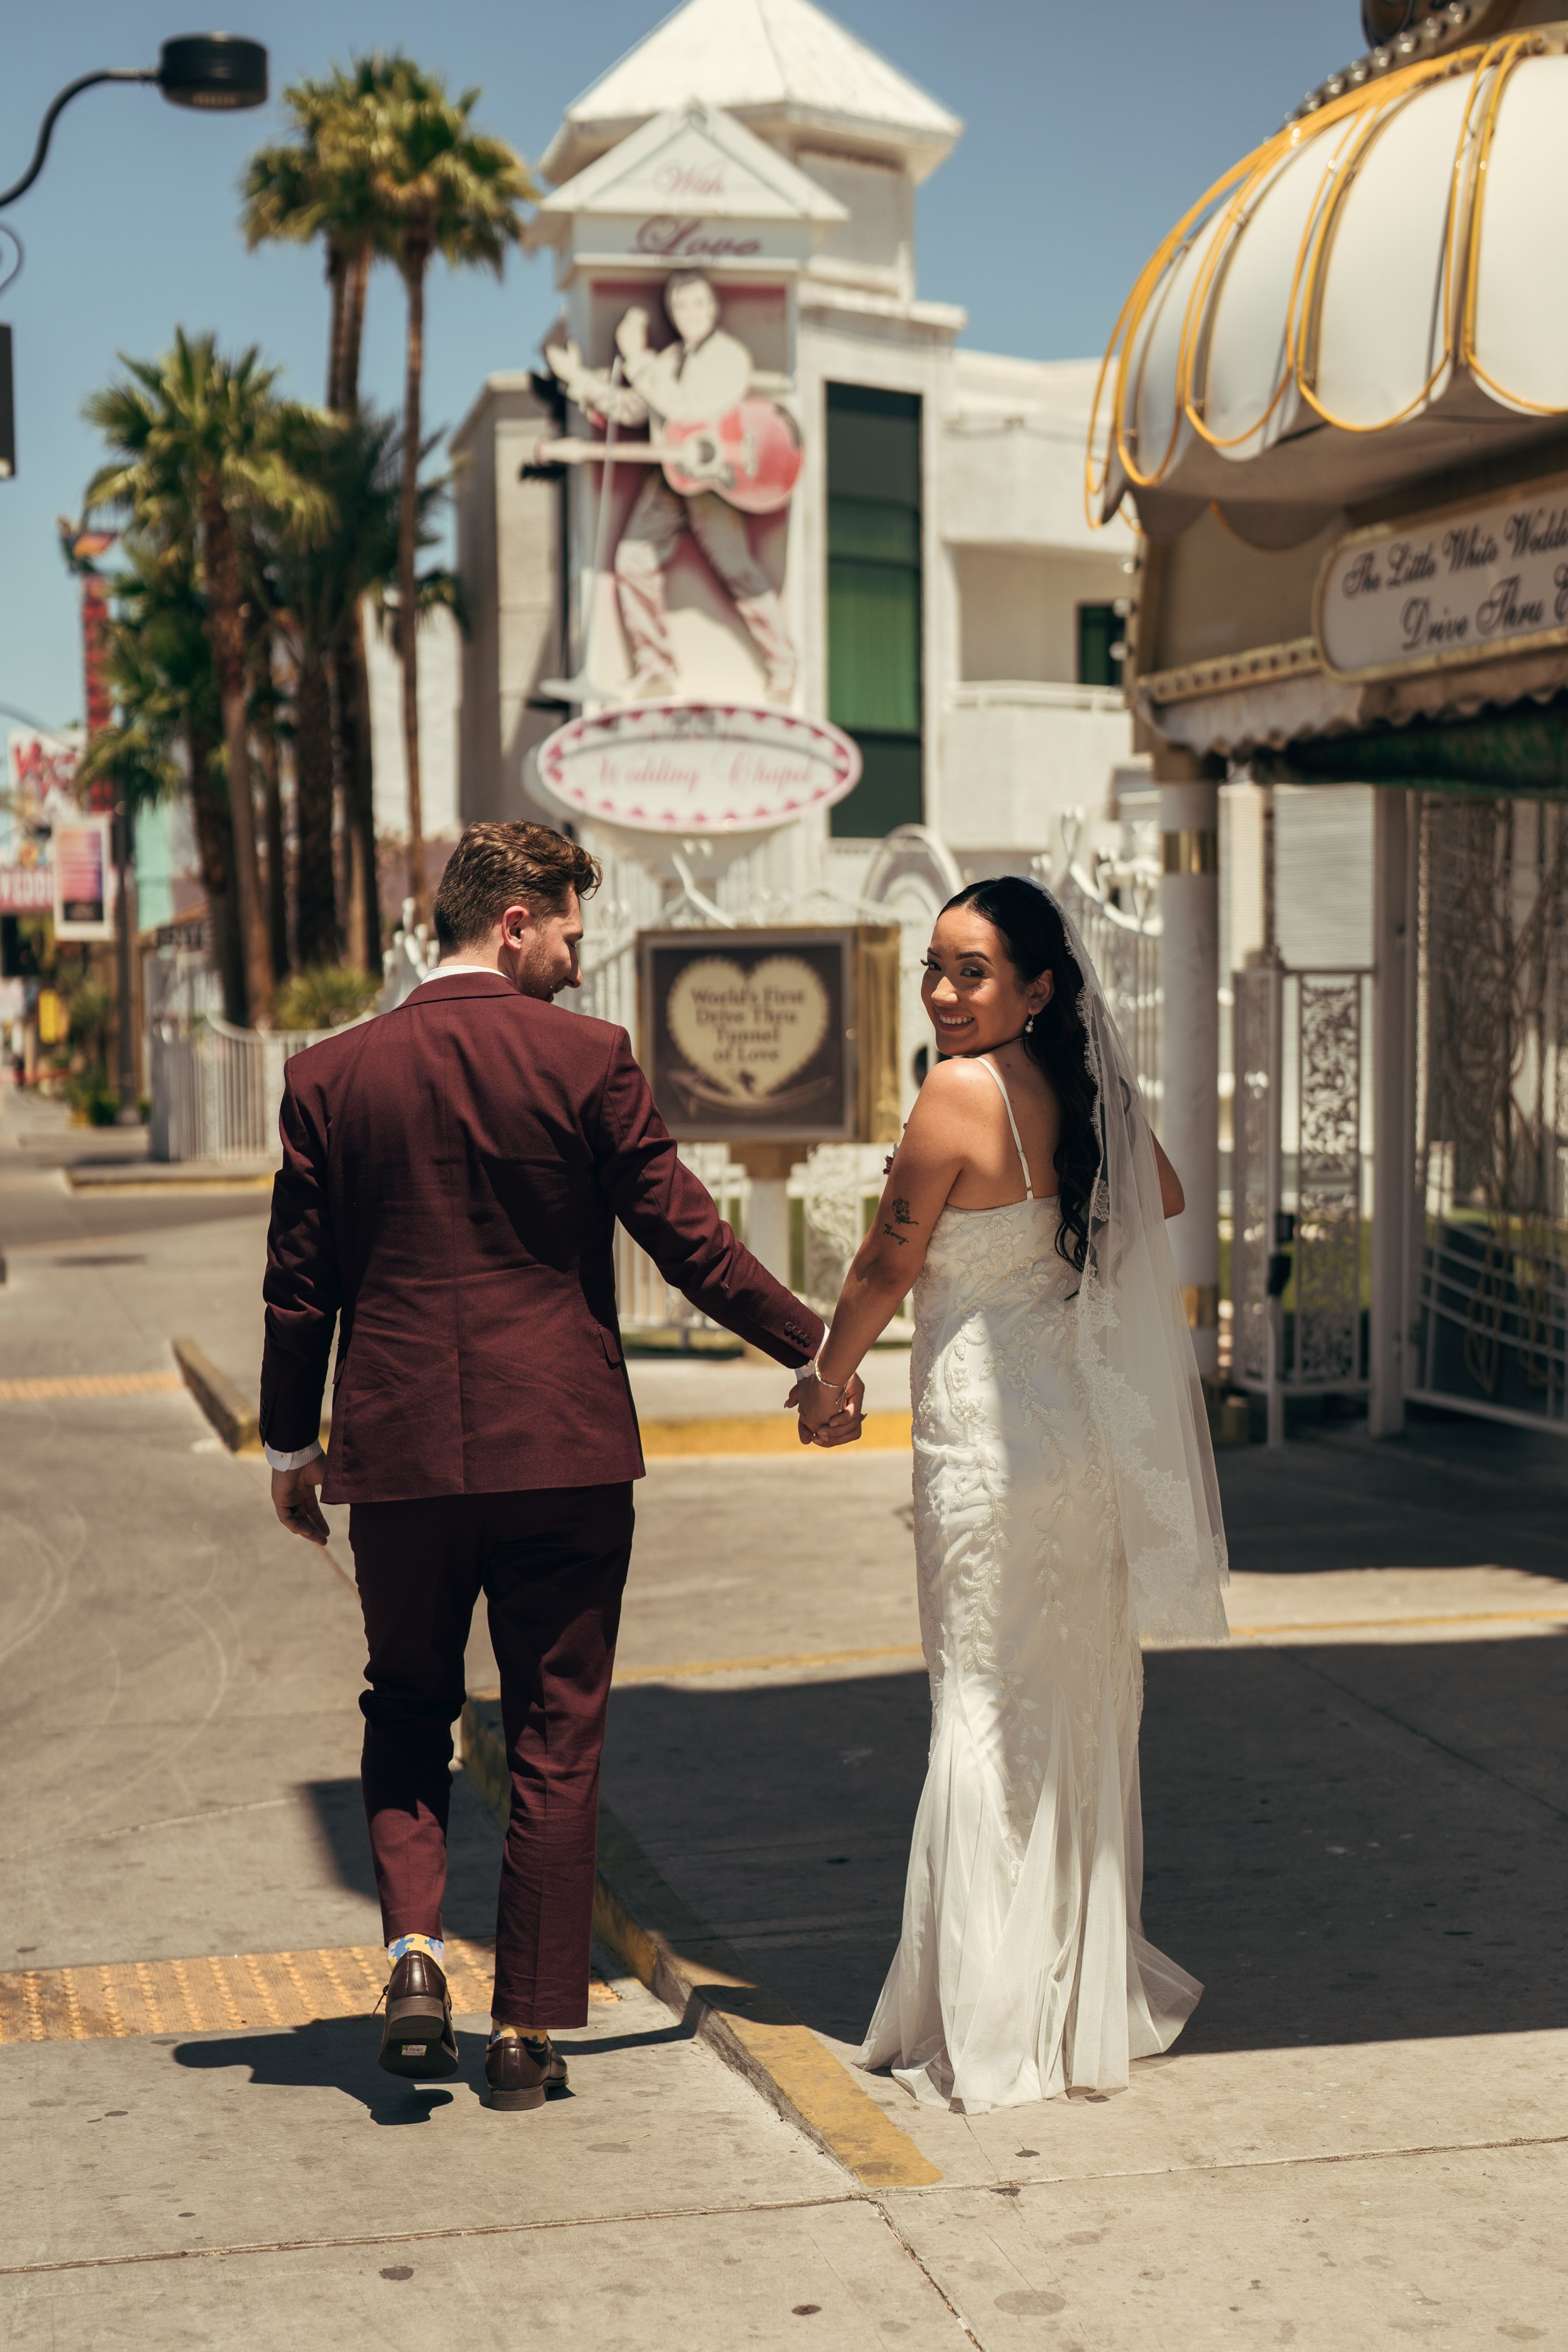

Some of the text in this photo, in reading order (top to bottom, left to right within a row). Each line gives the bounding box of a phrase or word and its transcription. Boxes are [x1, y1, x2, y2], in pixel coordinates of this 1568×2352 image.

[627, 213, 763, 256] Love
[1342, 550, 1381, 600] The
[1386, 541, 1437, 590] Little
[1441, 524, 1499, 572] White
[1400, 596, 1469, 651] Drive
[1475, 573, 1544, 636] Thru
[592, 748, 814, 797] Wedding Chapel
[691, 985, 806, 1004] World's First
[696, 1004, 798, 1024] Drive Thru
[715, 1025, 780, 1043] Tunnel
[713, 1045, 779, 1063] of Love
[882, 1223, 909, 1245] Honey
